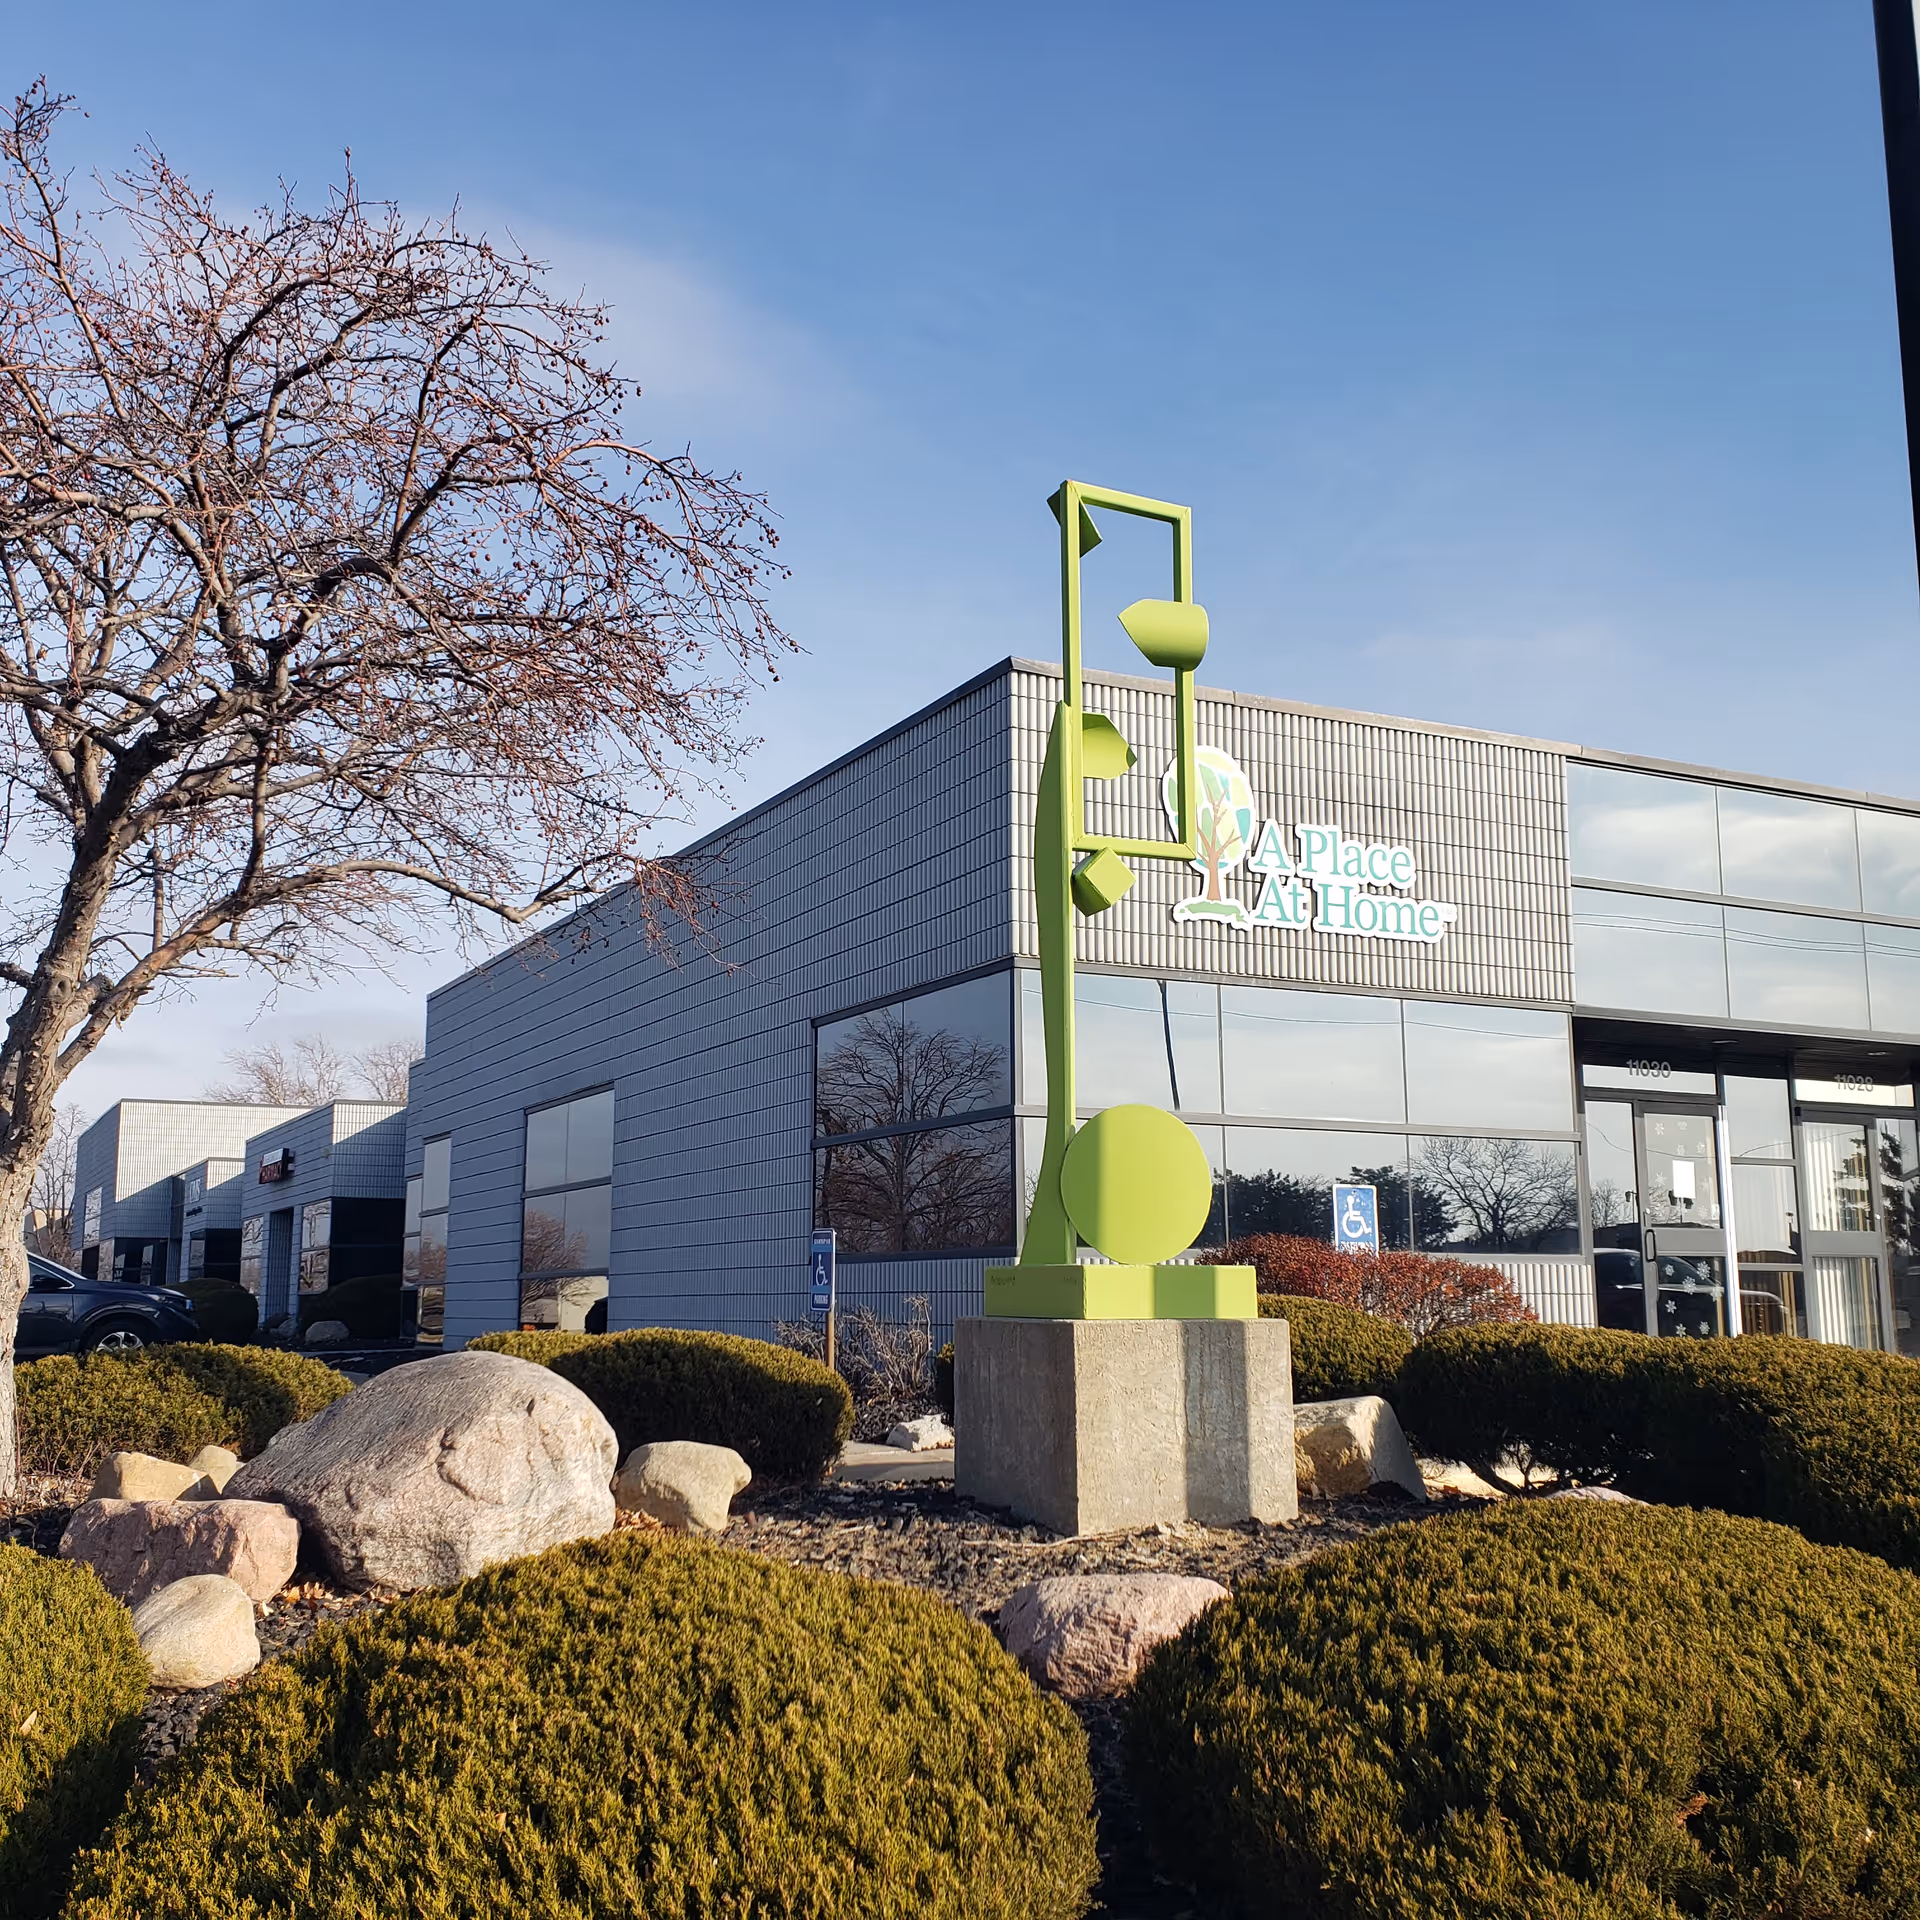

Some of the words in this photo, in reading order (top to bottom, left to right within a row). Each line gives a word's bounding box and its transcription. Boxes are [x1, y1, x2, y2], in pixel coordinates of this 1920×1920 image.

[1255, 824, 1291, 870] A
[1301, 829, 1412, 883] Place
[1254, 877, 1307, 925] At
[1318, 883, 1440, 937] Home
[1626, 1059, 1671, 1078] 11030
[1834, 1073, 1874, 1092] 11028
